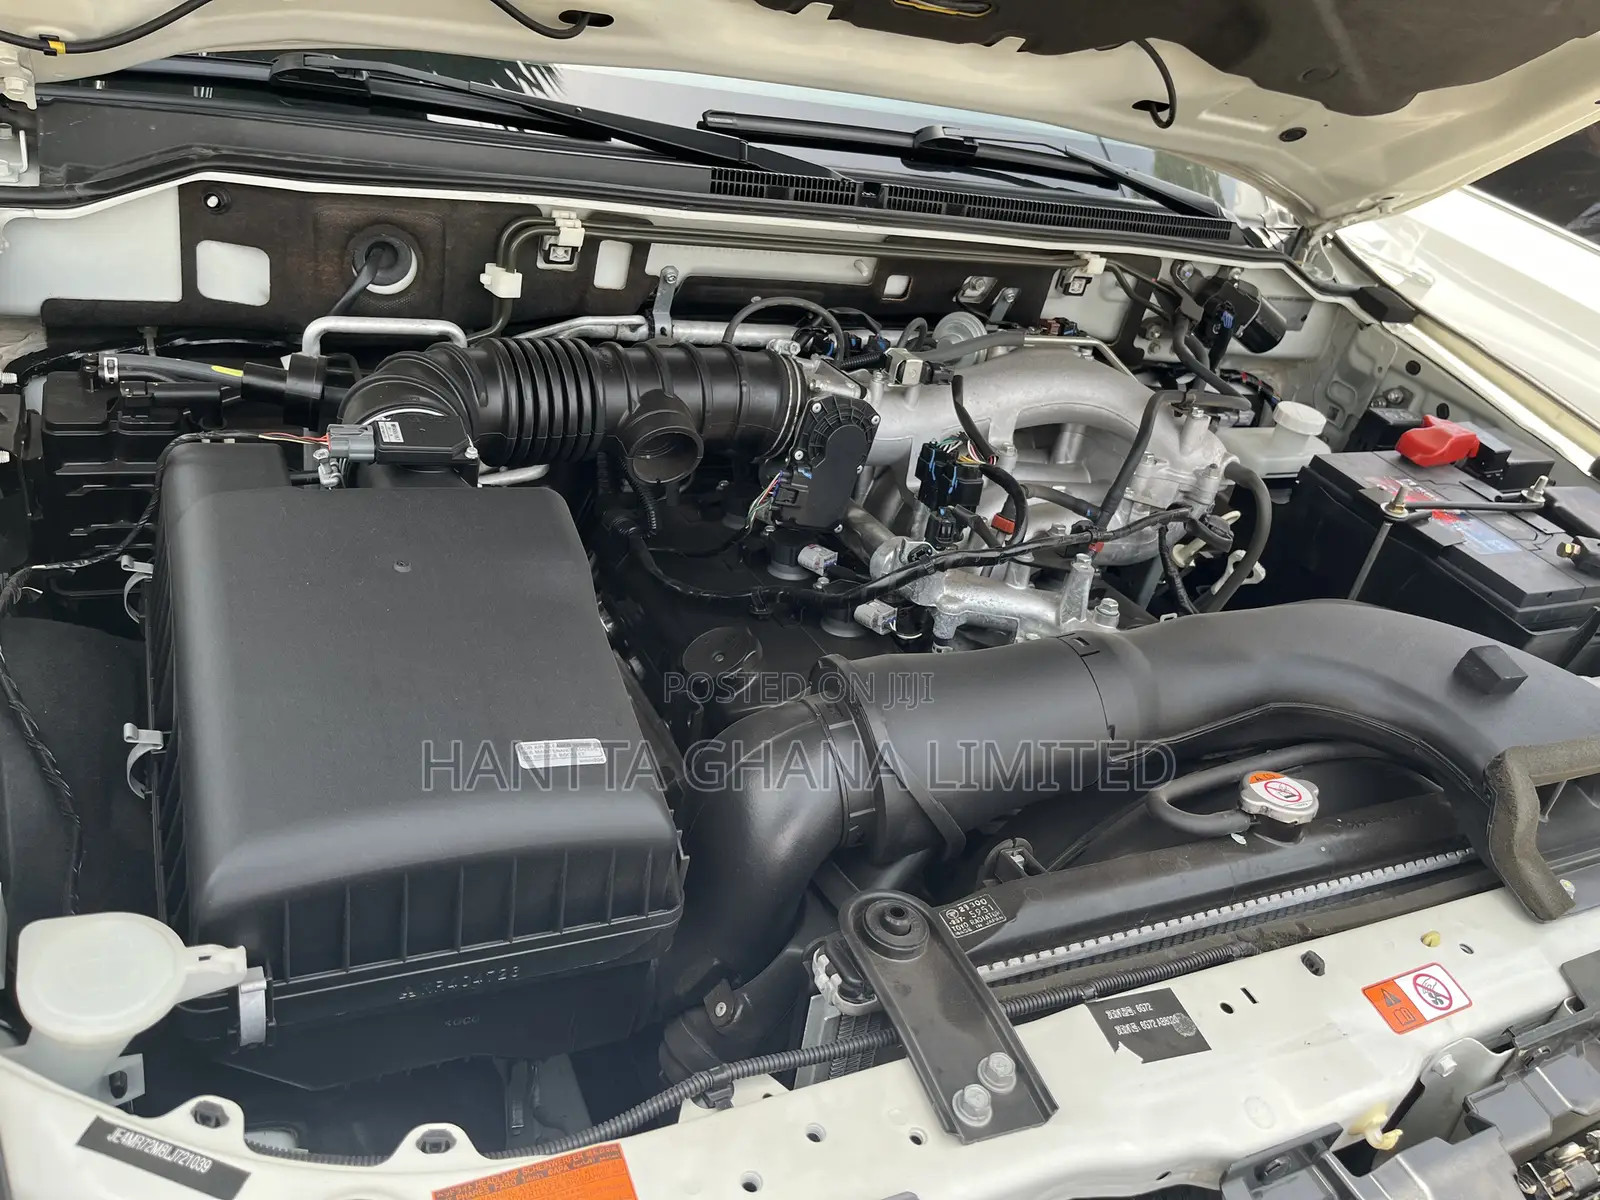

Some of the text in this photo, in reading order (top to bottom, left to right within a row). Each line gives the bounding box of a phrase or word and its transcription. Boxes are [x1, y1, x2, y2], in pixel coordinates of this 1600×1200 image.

[1135, 1002, 1153, 1013] 6G72
[1140, 1018, 1158, 1030] 6G72
[106, 1127, 213, 1174] JE4MR72M8LJ721039
[475, 1170, 519, 1188] HEADLAMP
[495, 1178, 517, 1191] FARO
